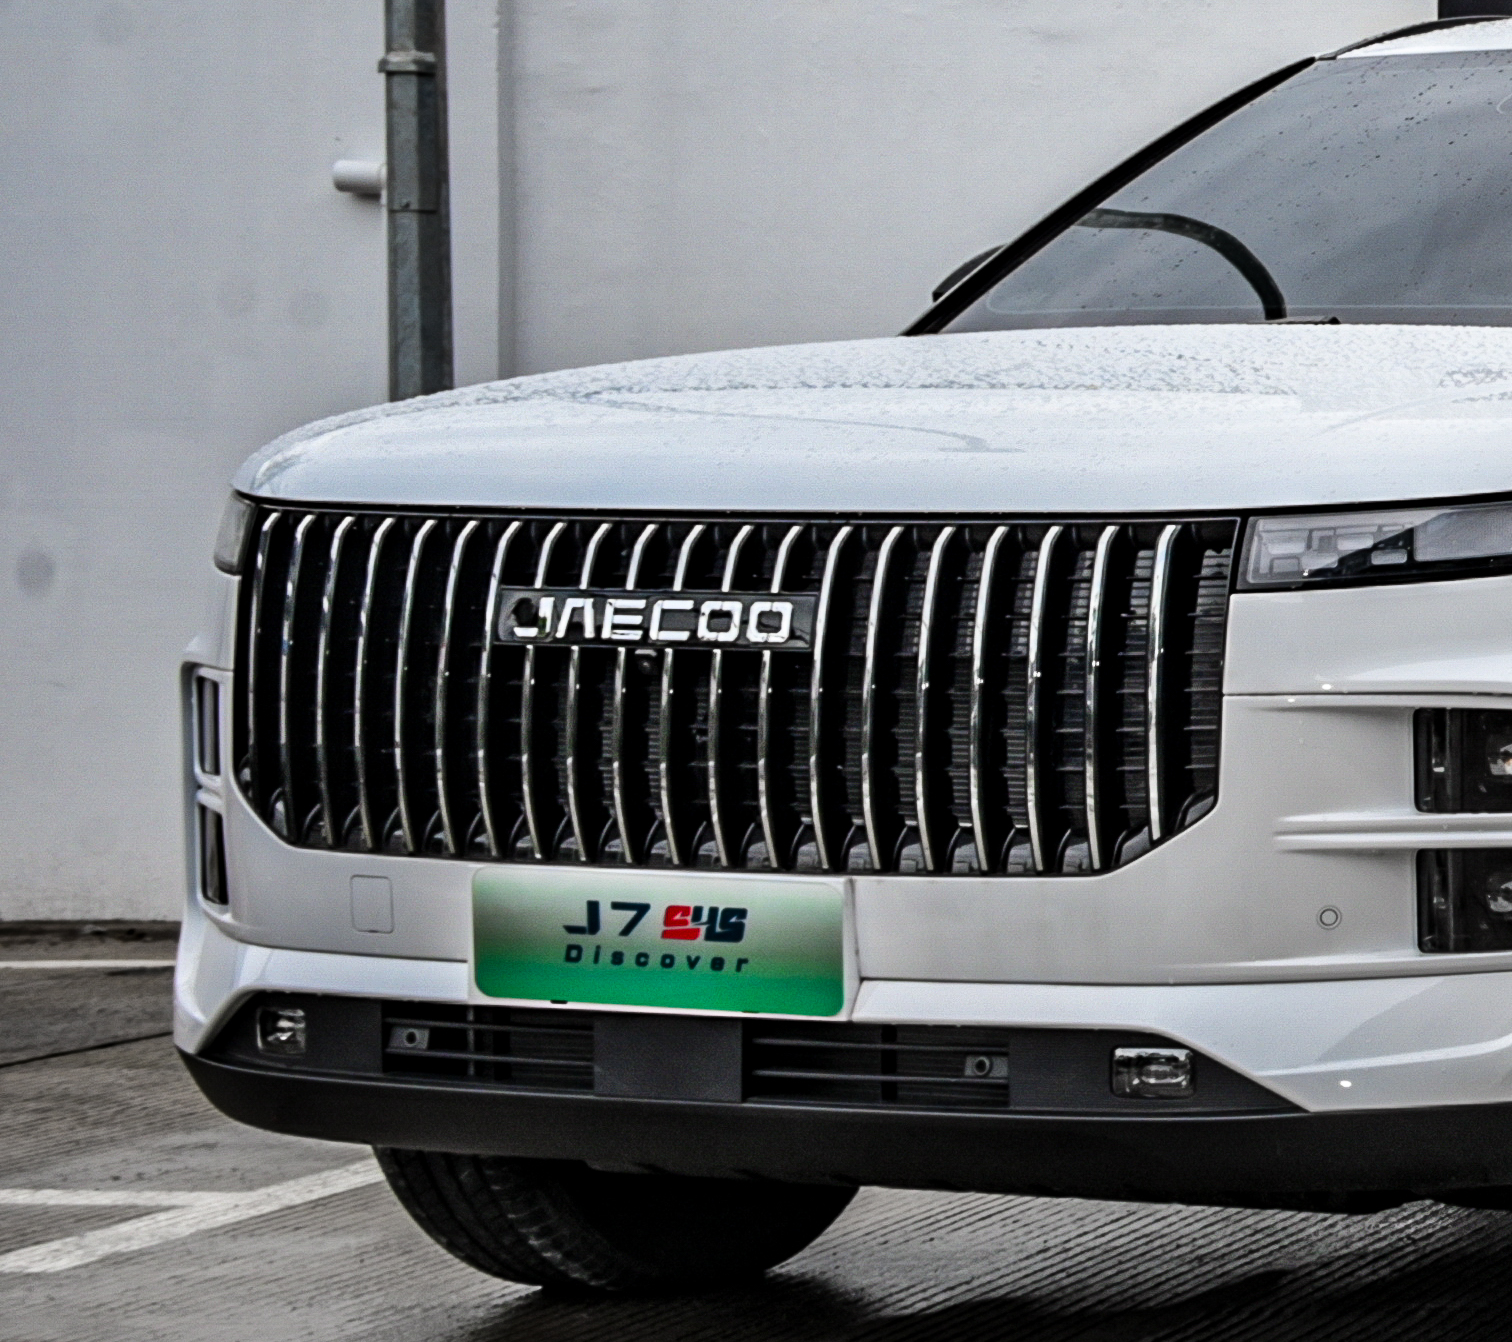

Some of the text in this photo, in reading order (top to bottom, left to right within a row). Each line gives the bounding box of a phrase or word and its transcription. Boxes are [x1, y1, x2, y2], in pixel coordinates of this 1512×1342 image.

[512, 597, 794, 644] JAECOO
[563, 899, 652, 937] J7
[564, 944, 750, 974] Discover
